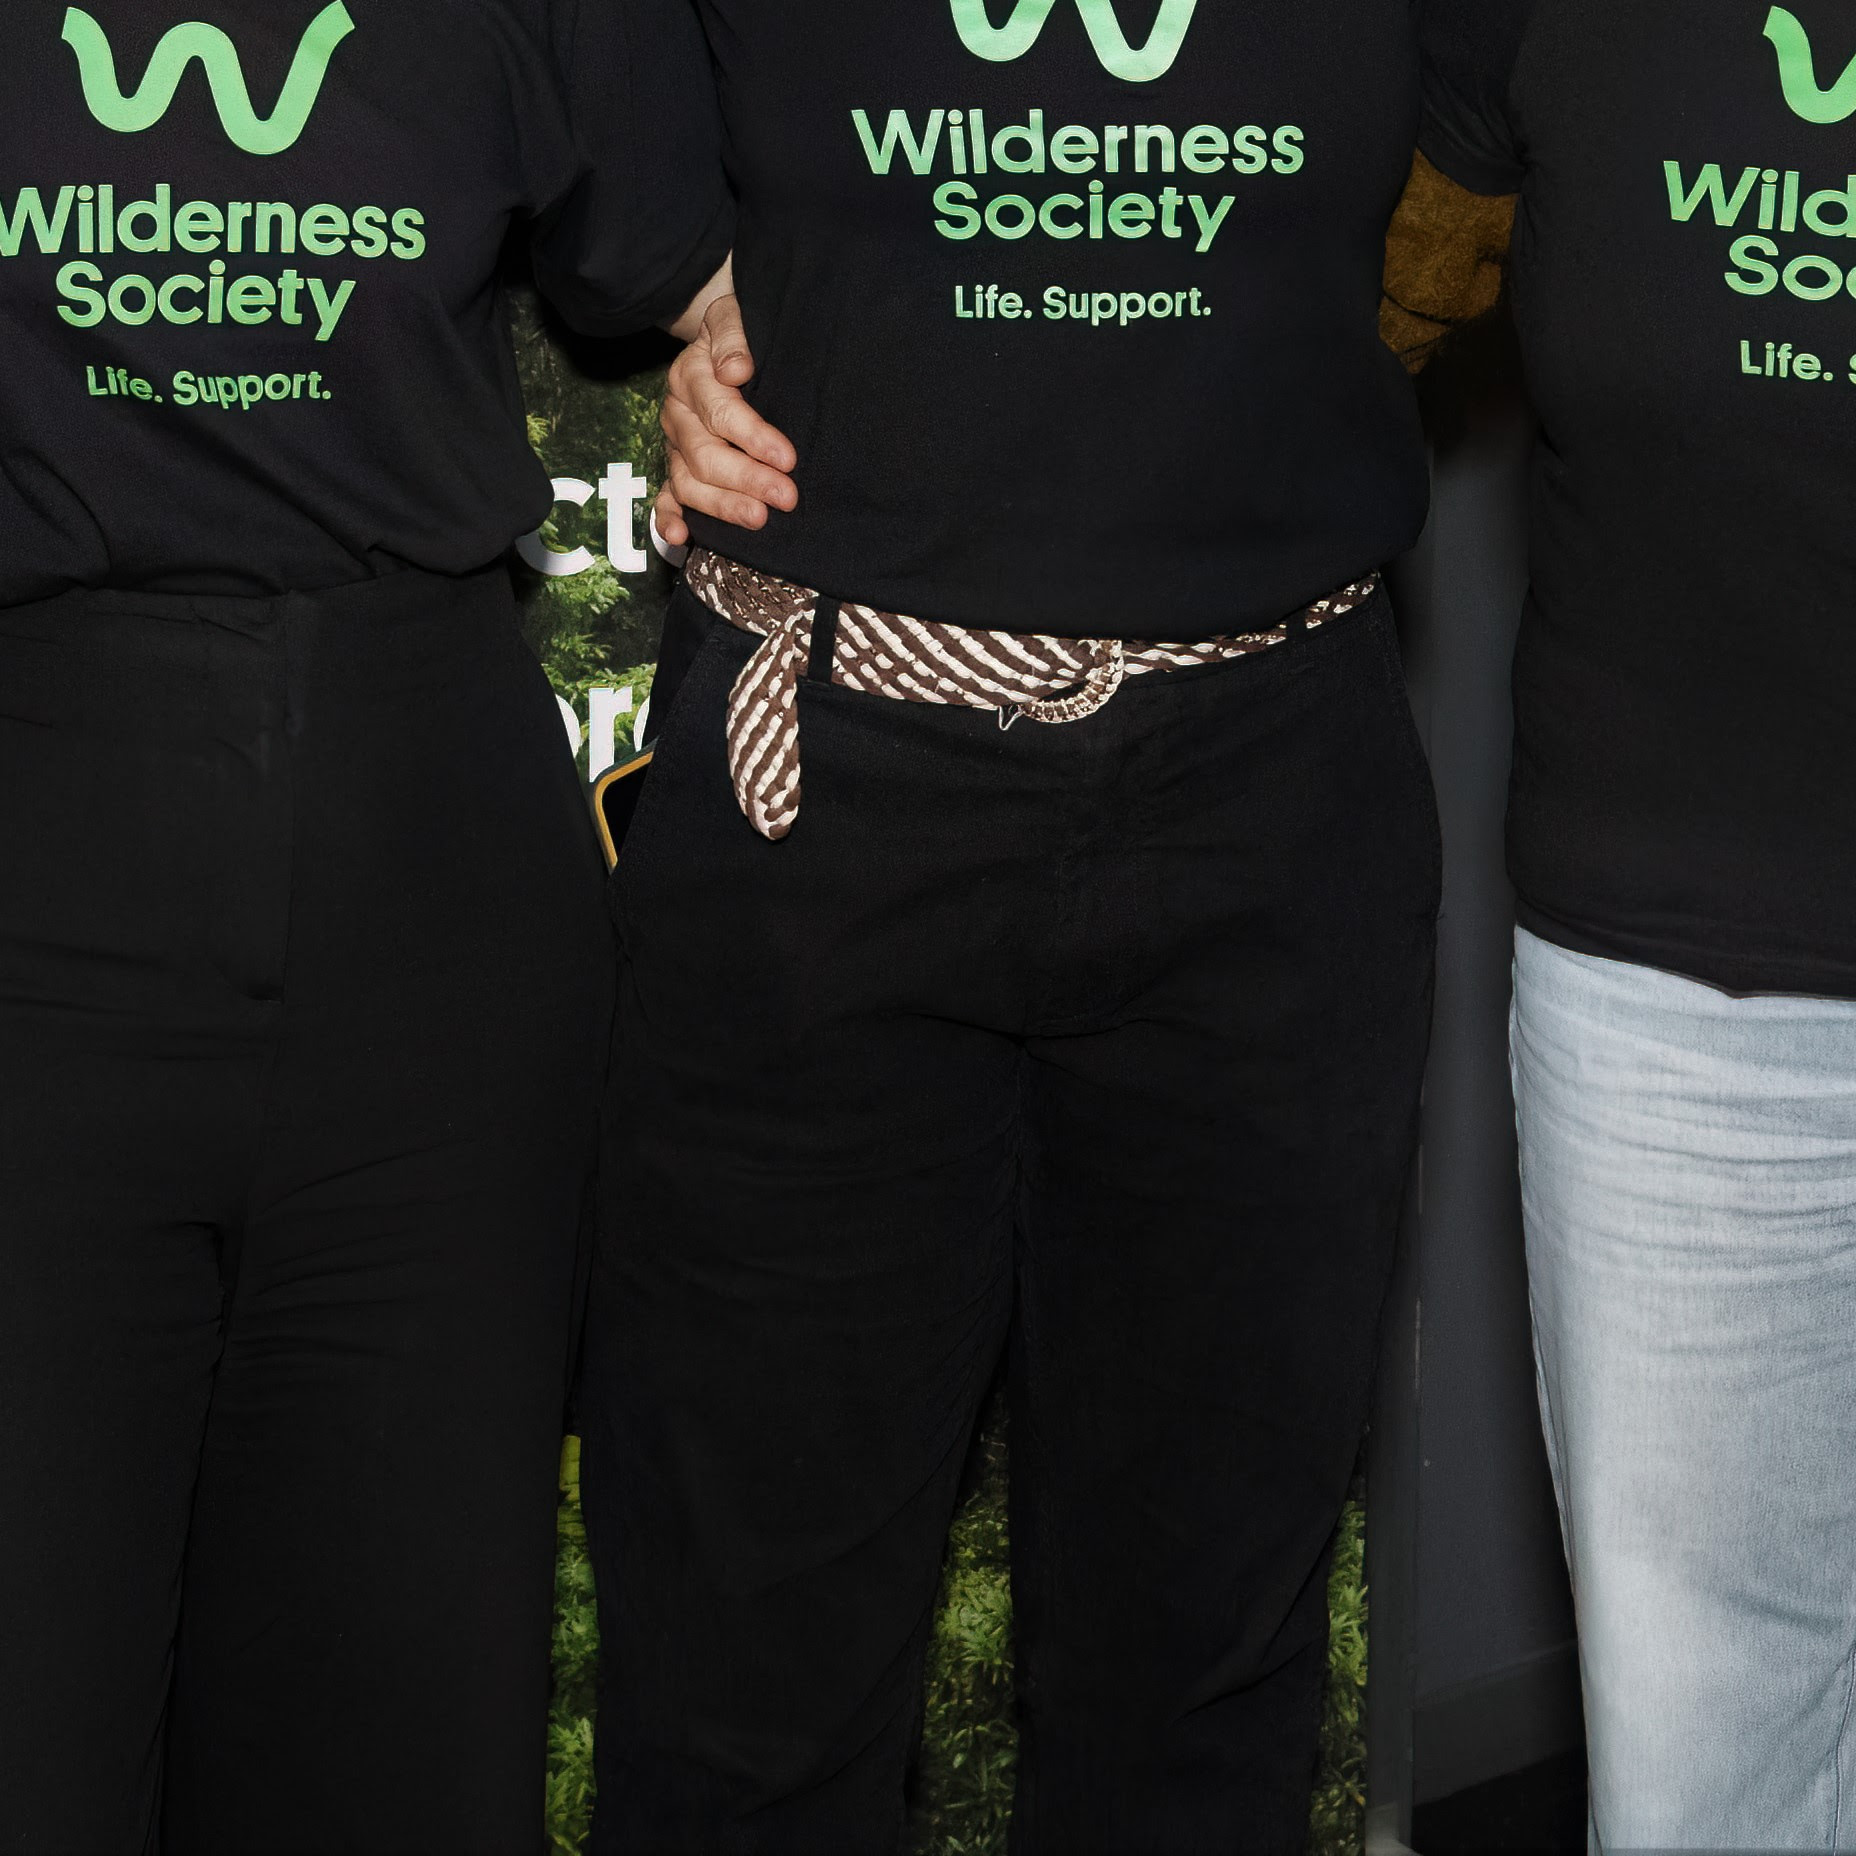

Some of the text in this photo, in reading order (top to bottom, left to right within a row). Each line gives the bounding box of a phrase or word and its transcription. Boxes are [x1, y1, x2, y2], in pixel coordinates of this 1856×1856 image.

[851, 109, 1305, 175] Wilderness
[933, 180, 1236, 253] Society
[56, 260, 356, 342] Society
[955, 285, 1212, 327] Life. Support.
[86, 366, 331, 410] Life. Support.
[1740, 340, 1834, 382] Life.
